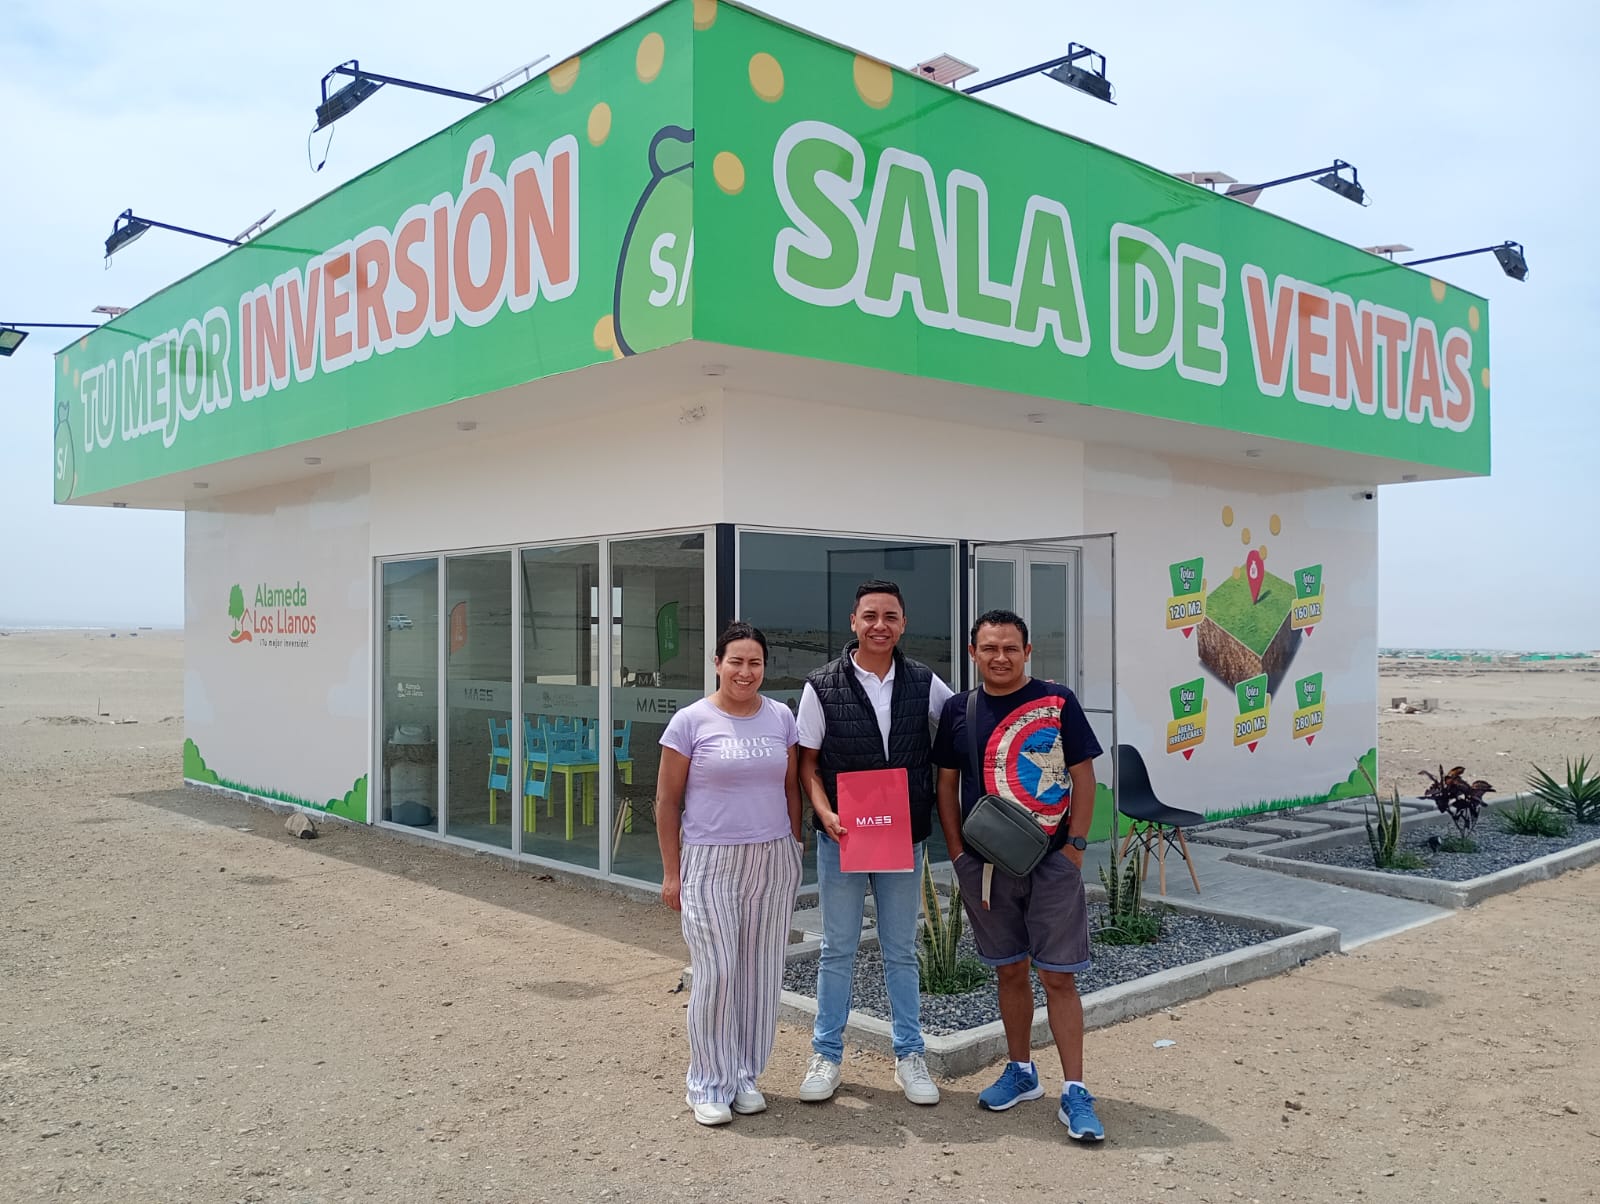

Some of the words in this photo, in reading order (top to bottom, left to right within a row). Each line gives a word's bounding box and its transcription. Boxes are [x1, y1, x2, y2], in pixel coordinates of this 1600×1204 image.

[773, 121, 1091, 358] SALA
[1110, 222, 1227, 387] DE
[1241, 264, 1476, 433] VENTAS
[81, 357, 117, 453] TU
[121, 306, 232, 449] MEJOR
[239, 134, 579, 401] INVERSIÓN
[255, 580, 307, 607] Alameda
[1169, 604, 1186, 620] 120
[1188, 601, 1202, 617] M2
[1294, 606, 1308, 620] 160
[253, 608, 274, 634] Los
[277, 607, 317, 634] Llanos
[464, 687, 494, 702] MAES
[636, 697, 677, 713] MAES
[1236, 720, 1252, 737] 200
[1253, 716, 1267, 732] M2
[1310, 711, 1323, 726] M2
[720, 736, 770, 748] more
[720, 747, 773, 760] amor
[856, 815, 892, 825] MAES
